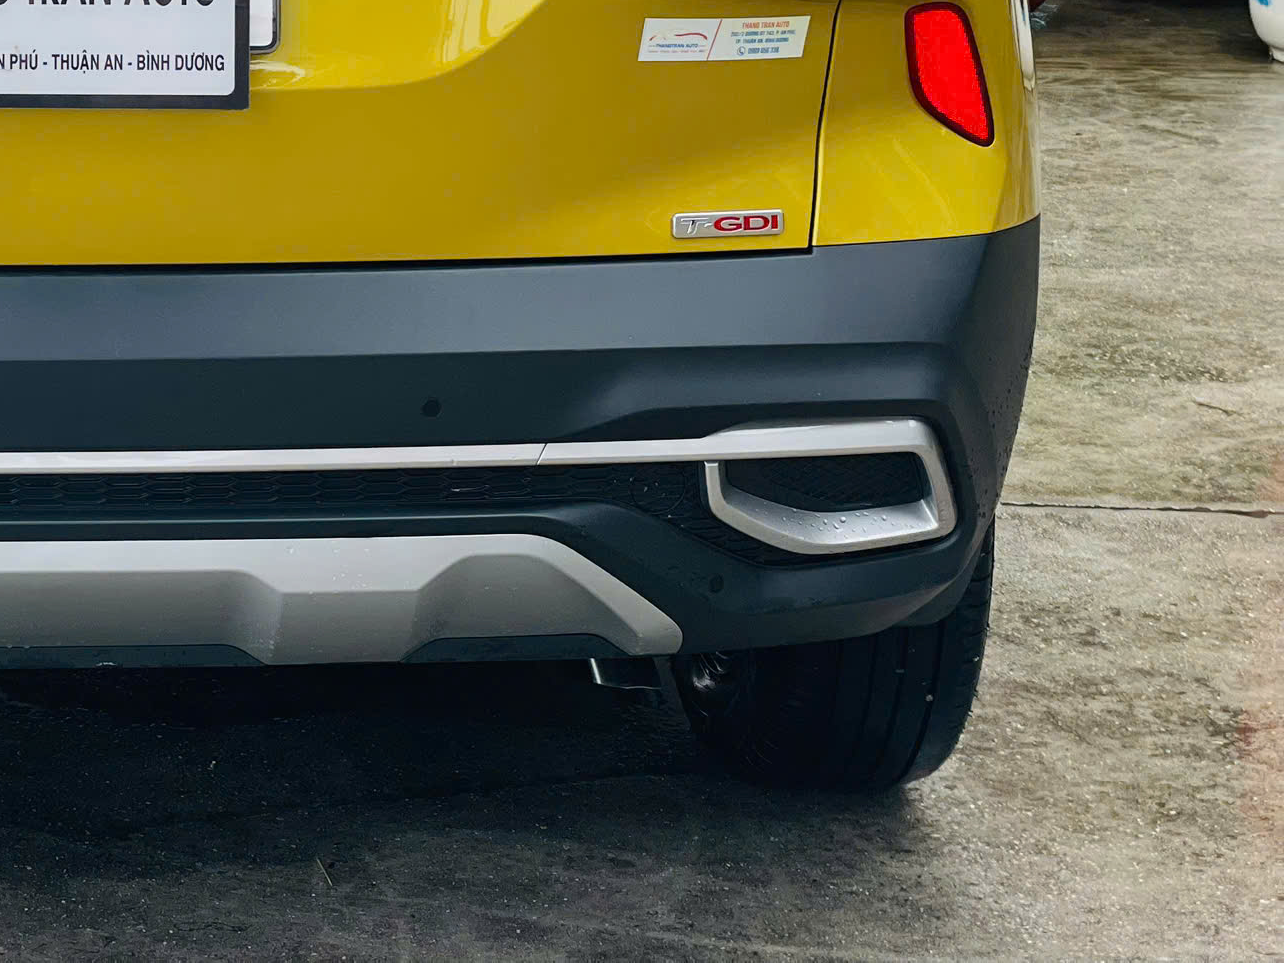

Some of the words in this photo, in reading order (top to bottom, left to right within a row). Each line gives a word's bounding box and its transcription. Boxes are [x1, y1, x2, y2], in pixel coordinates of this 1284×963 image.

[9, 49, 39, 70] PHÚ
[51, 49, 100, 74] THUẬN
[103, 54, 124, 71] AN
[136, 50, 171, 71] BÌNH
[174, 52, 226, 71] DƯƠNG
